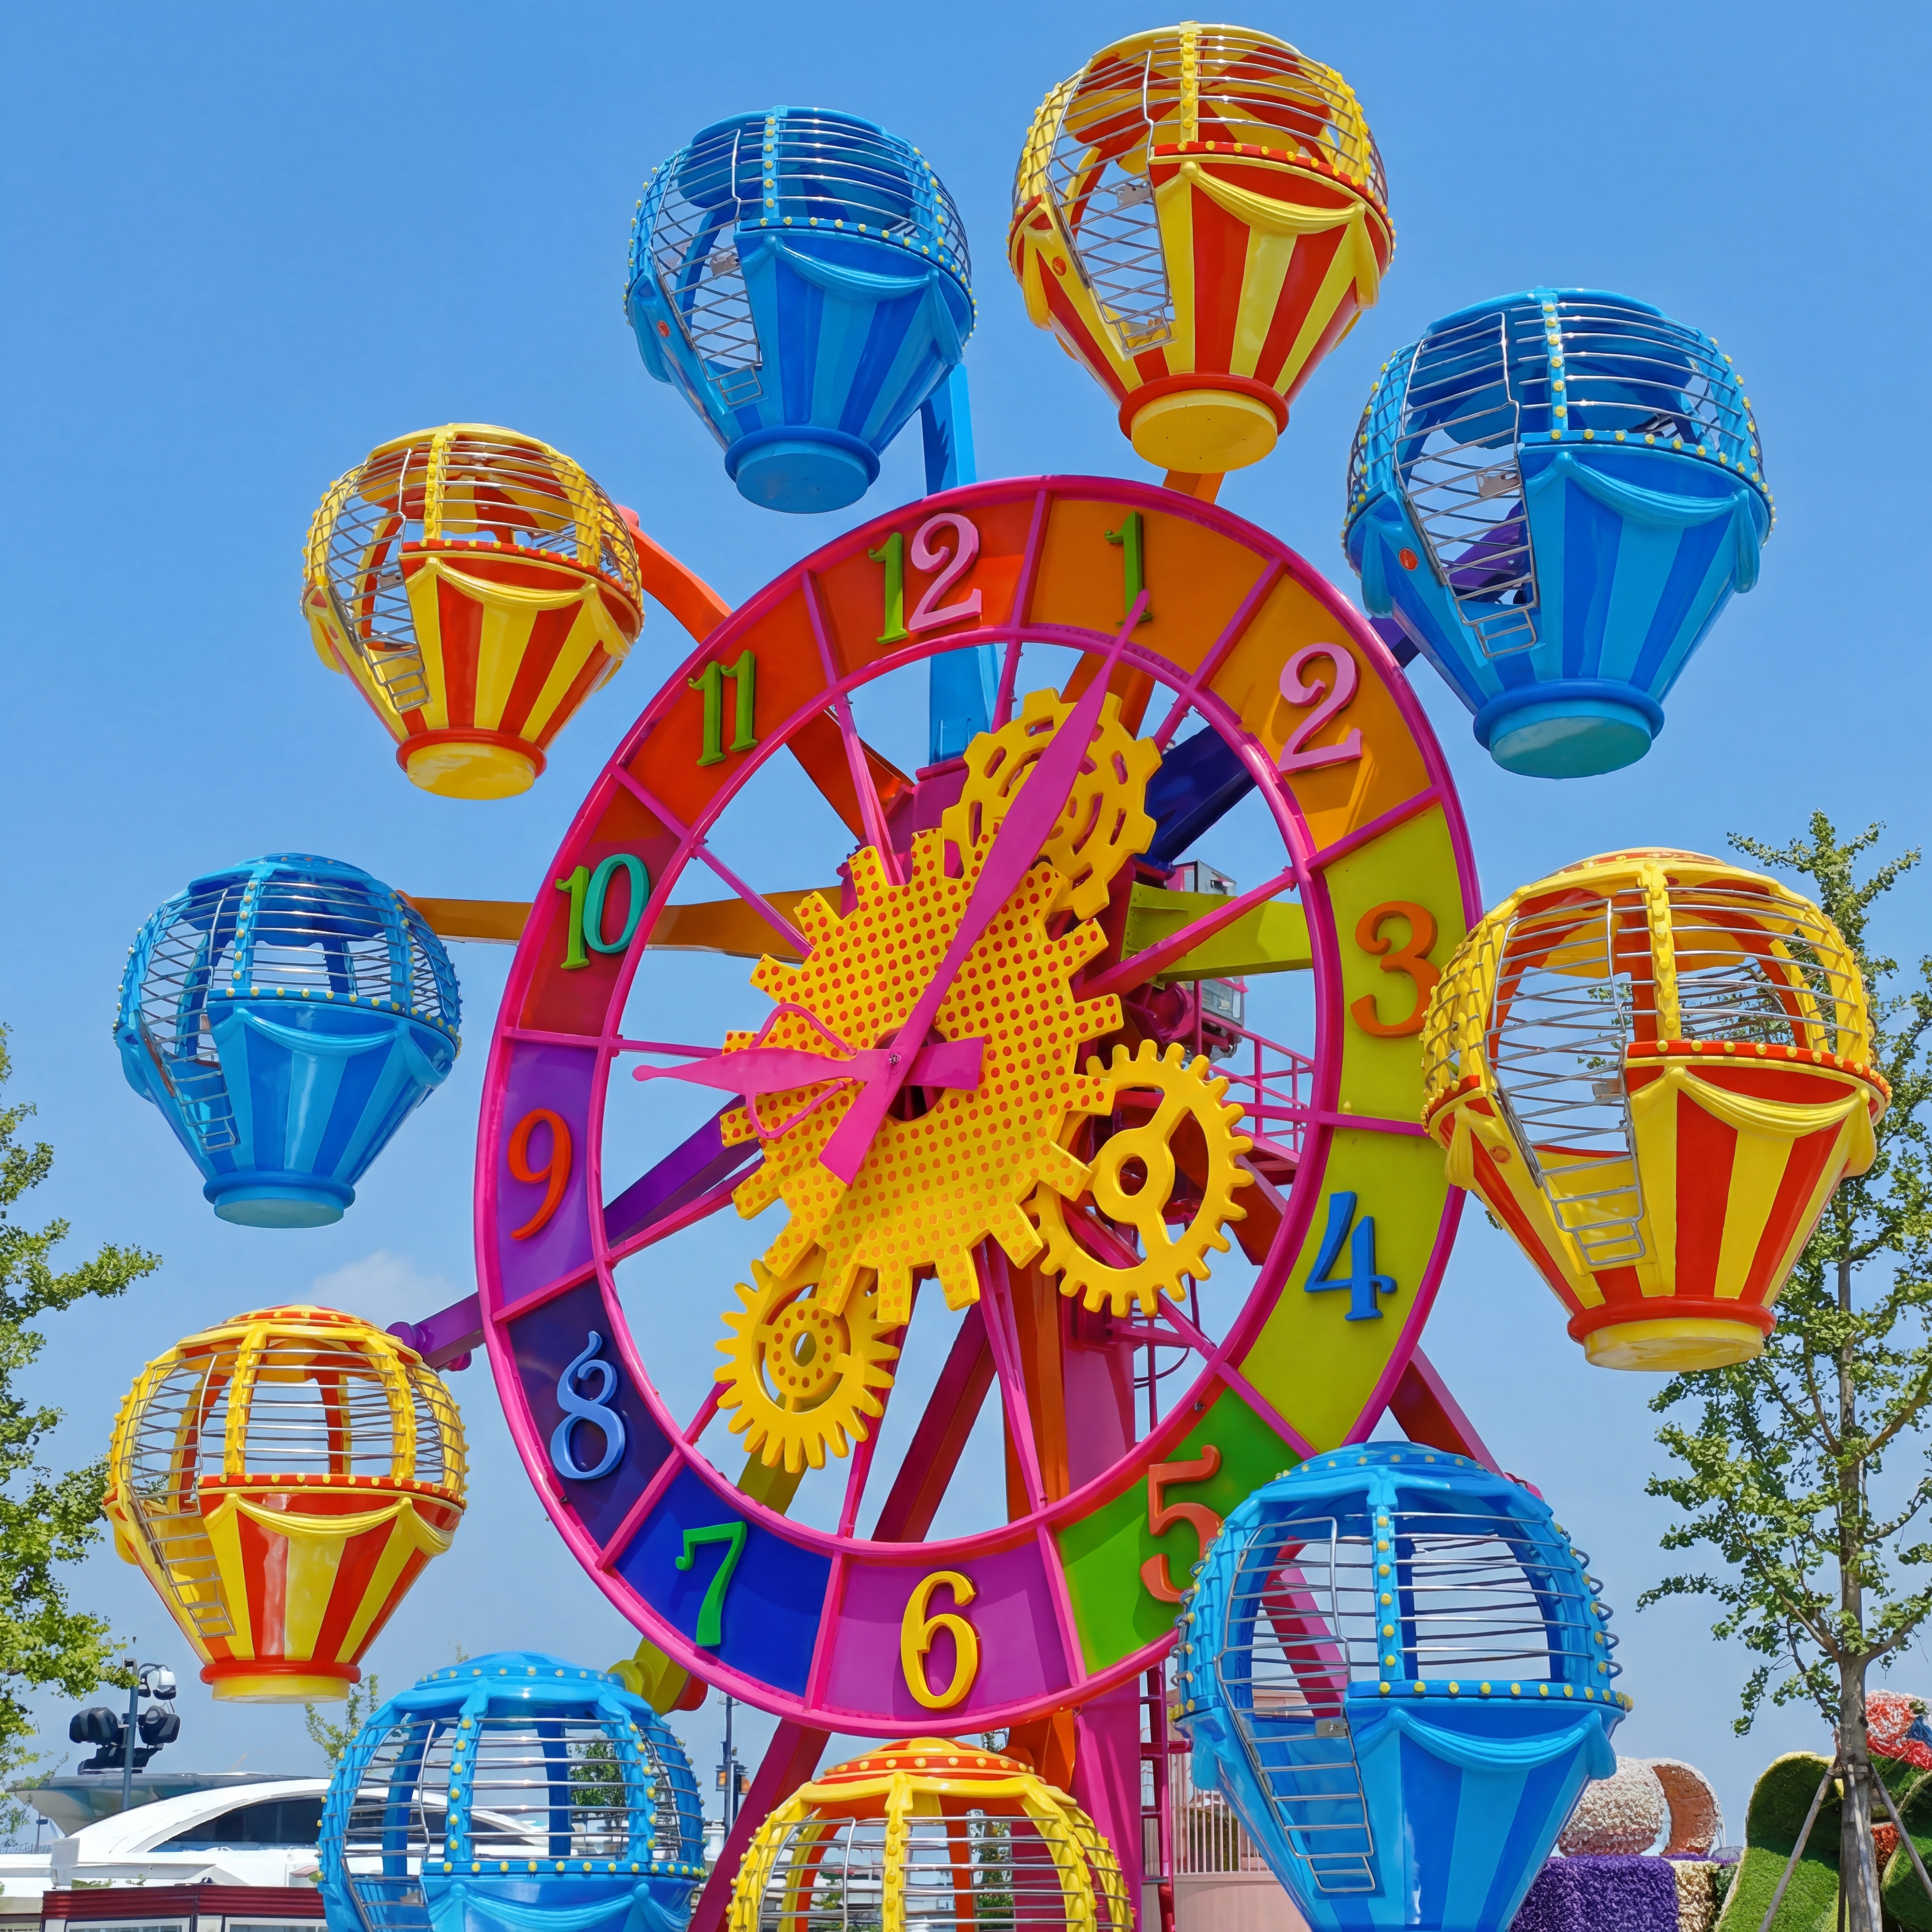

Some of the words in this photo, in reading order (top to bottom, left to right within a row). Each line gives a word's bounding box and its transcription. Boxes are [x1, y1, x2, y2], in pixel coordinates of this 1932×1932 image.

[868, 513, 982, 644] 12
[1105, 511, 1152, 626] 1
[688, 650, 758, 766] 11
[1278, 643, 1363, 774] 2
[556, 854, 649, 969] 10
[1350, 900, 1441, 1038] 3
[508, 1108, 571, 1240] 9
[1304, 1191, 1397, 1321] 4
[550, 1331, 625, 1480] 8
[675, 1521, 747, 1647] 7
[1140, 1445, 1223, 1604] 5
[901, 1570, 979, 1709] 6
